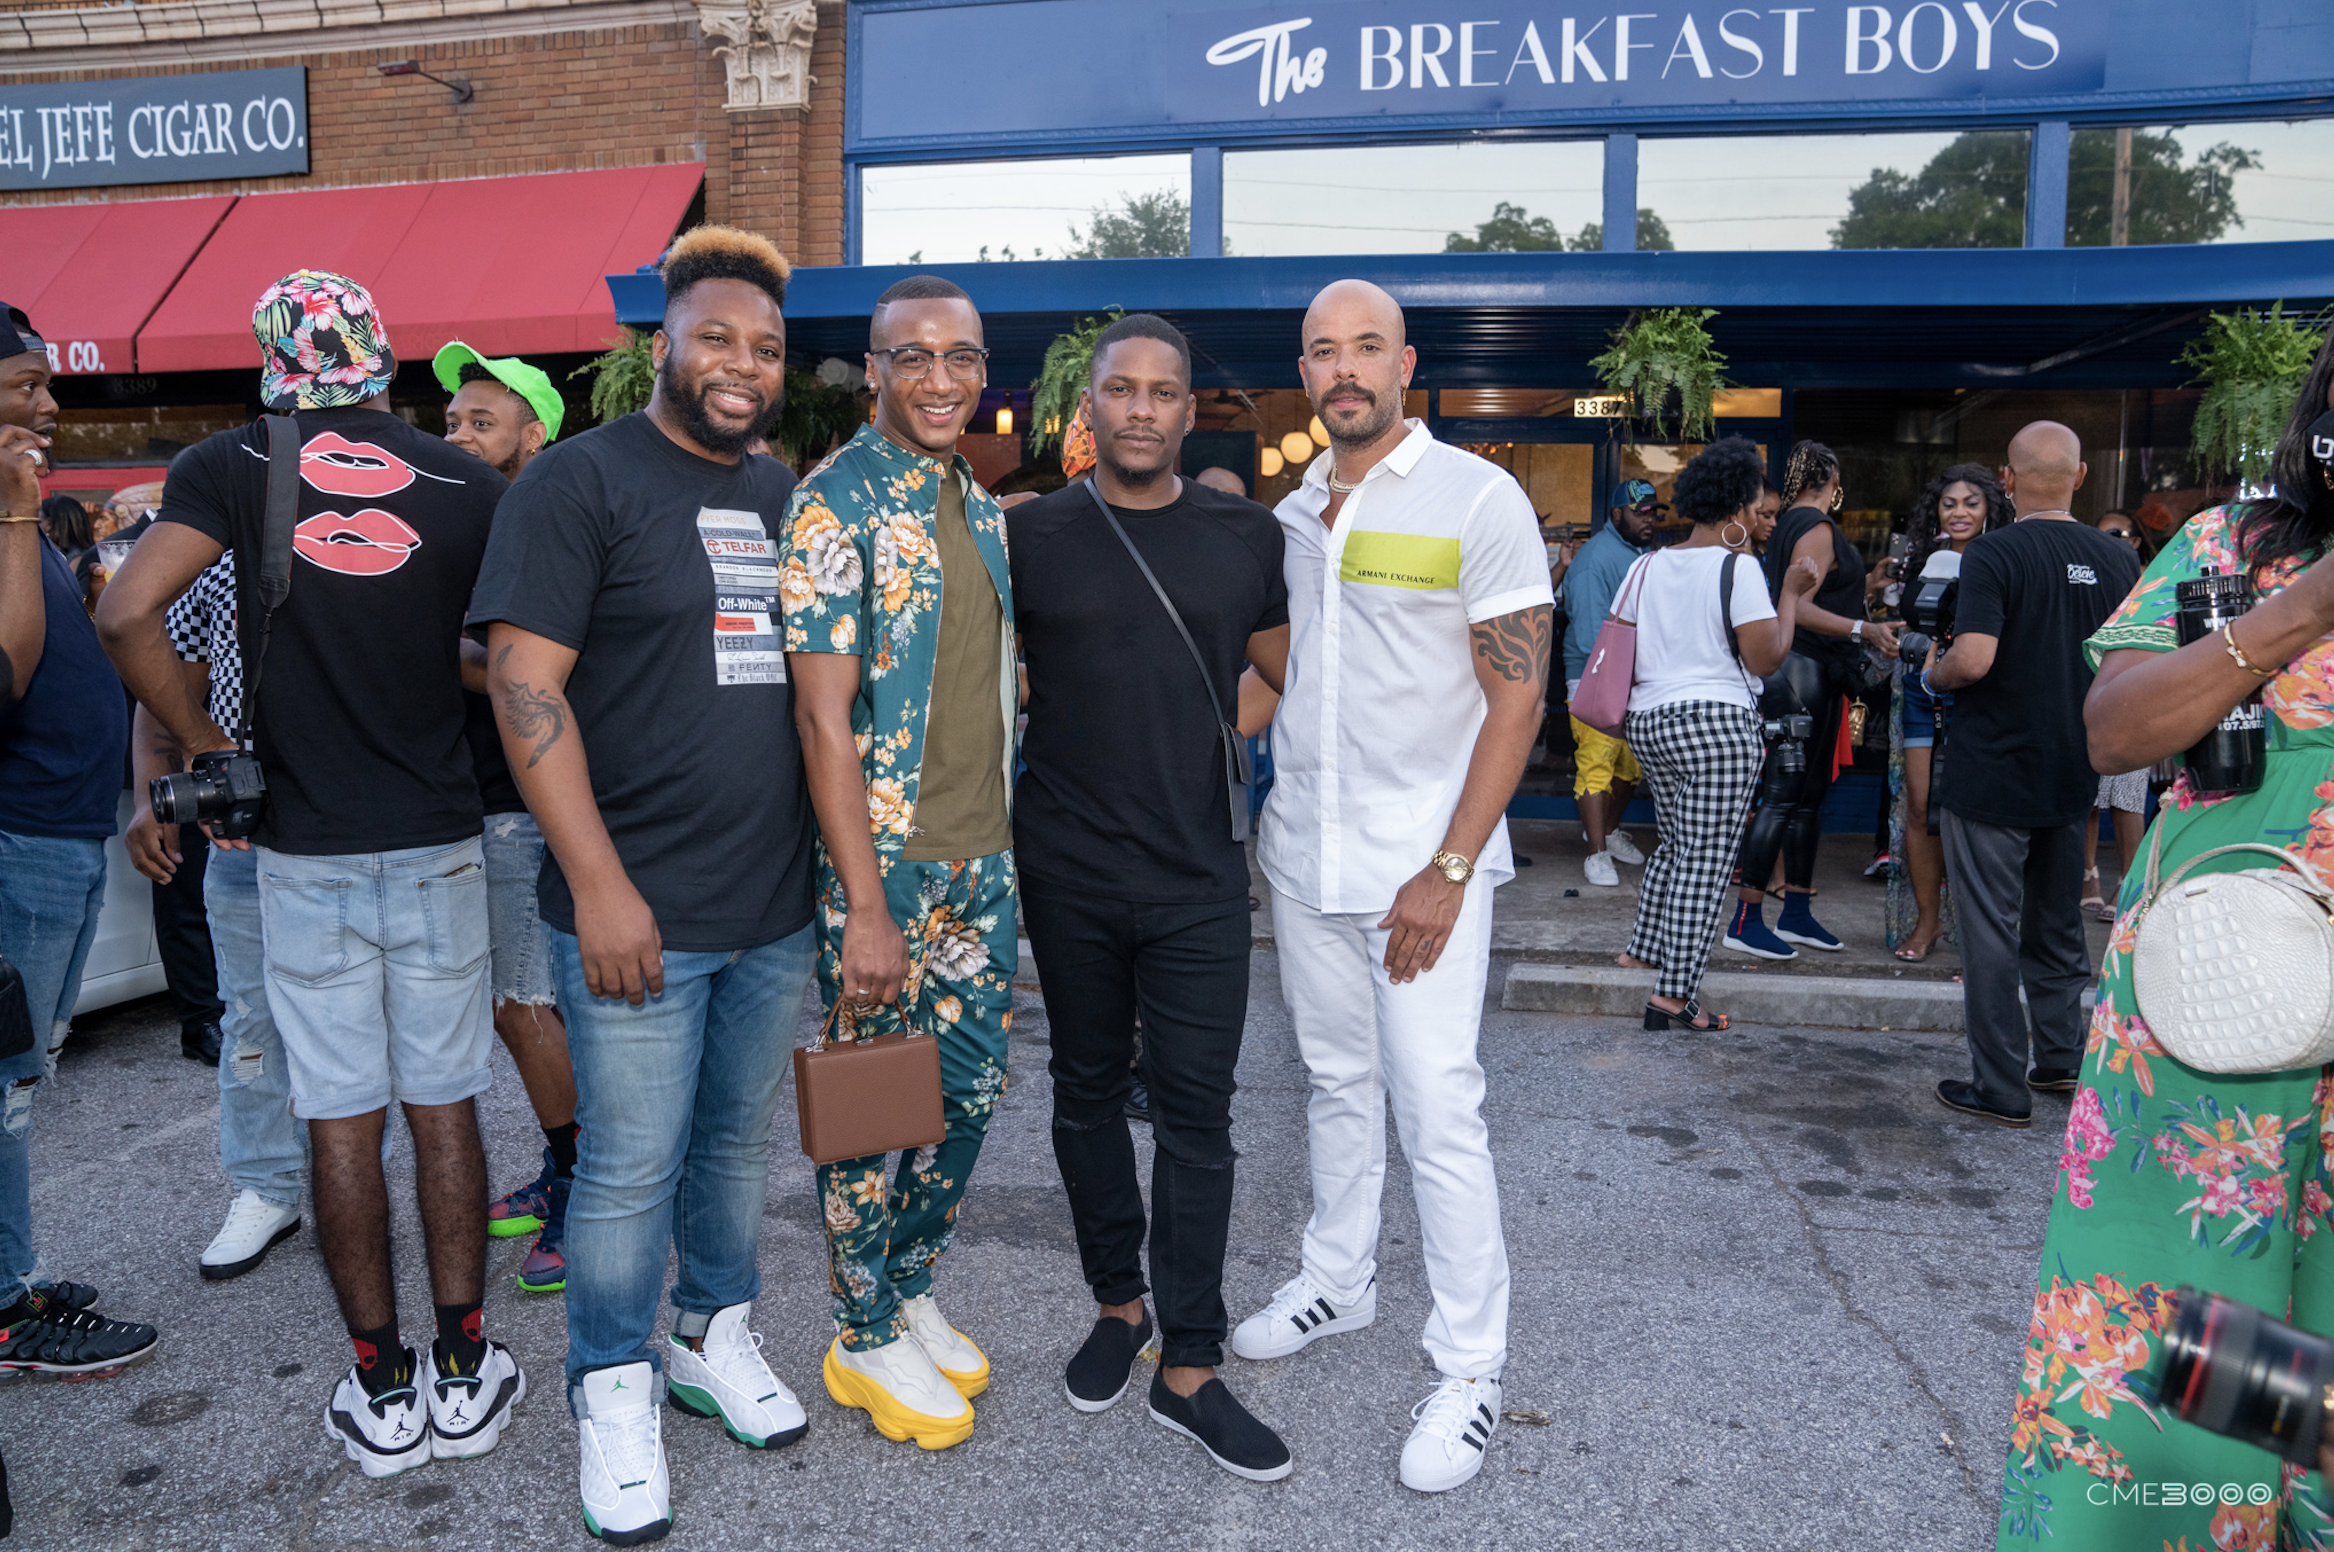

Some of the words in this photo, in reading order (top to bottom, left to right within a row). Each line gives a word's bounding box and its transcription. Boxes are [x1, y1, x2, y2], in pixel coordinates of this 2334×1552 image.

[1360, 8, 1815, 91] BREAKFAST
[1845, 0, 2060, 74] BOYS
[1205, 17, 1328, 107] The
[36, 101, 115, 180] JEFE
[128, 99, 238, 159] CIGAR
[242, 95, 304, 152] CO.
[68, 341, 105, 372] CO.
[1577, 401, 1621, 415] 3387
[700, 514, 721, 523] PYER
[723, 516, 747, 525] MOSS
[721, 541, 767, 554] TELFAR
[1357, 570, 1387, 579] ARMANI
[1390, 573, 1436, 584] EXCHANGE
[716, 636, 754, 650] YEEZY
[2223, 704, 2265, 721] AJI
